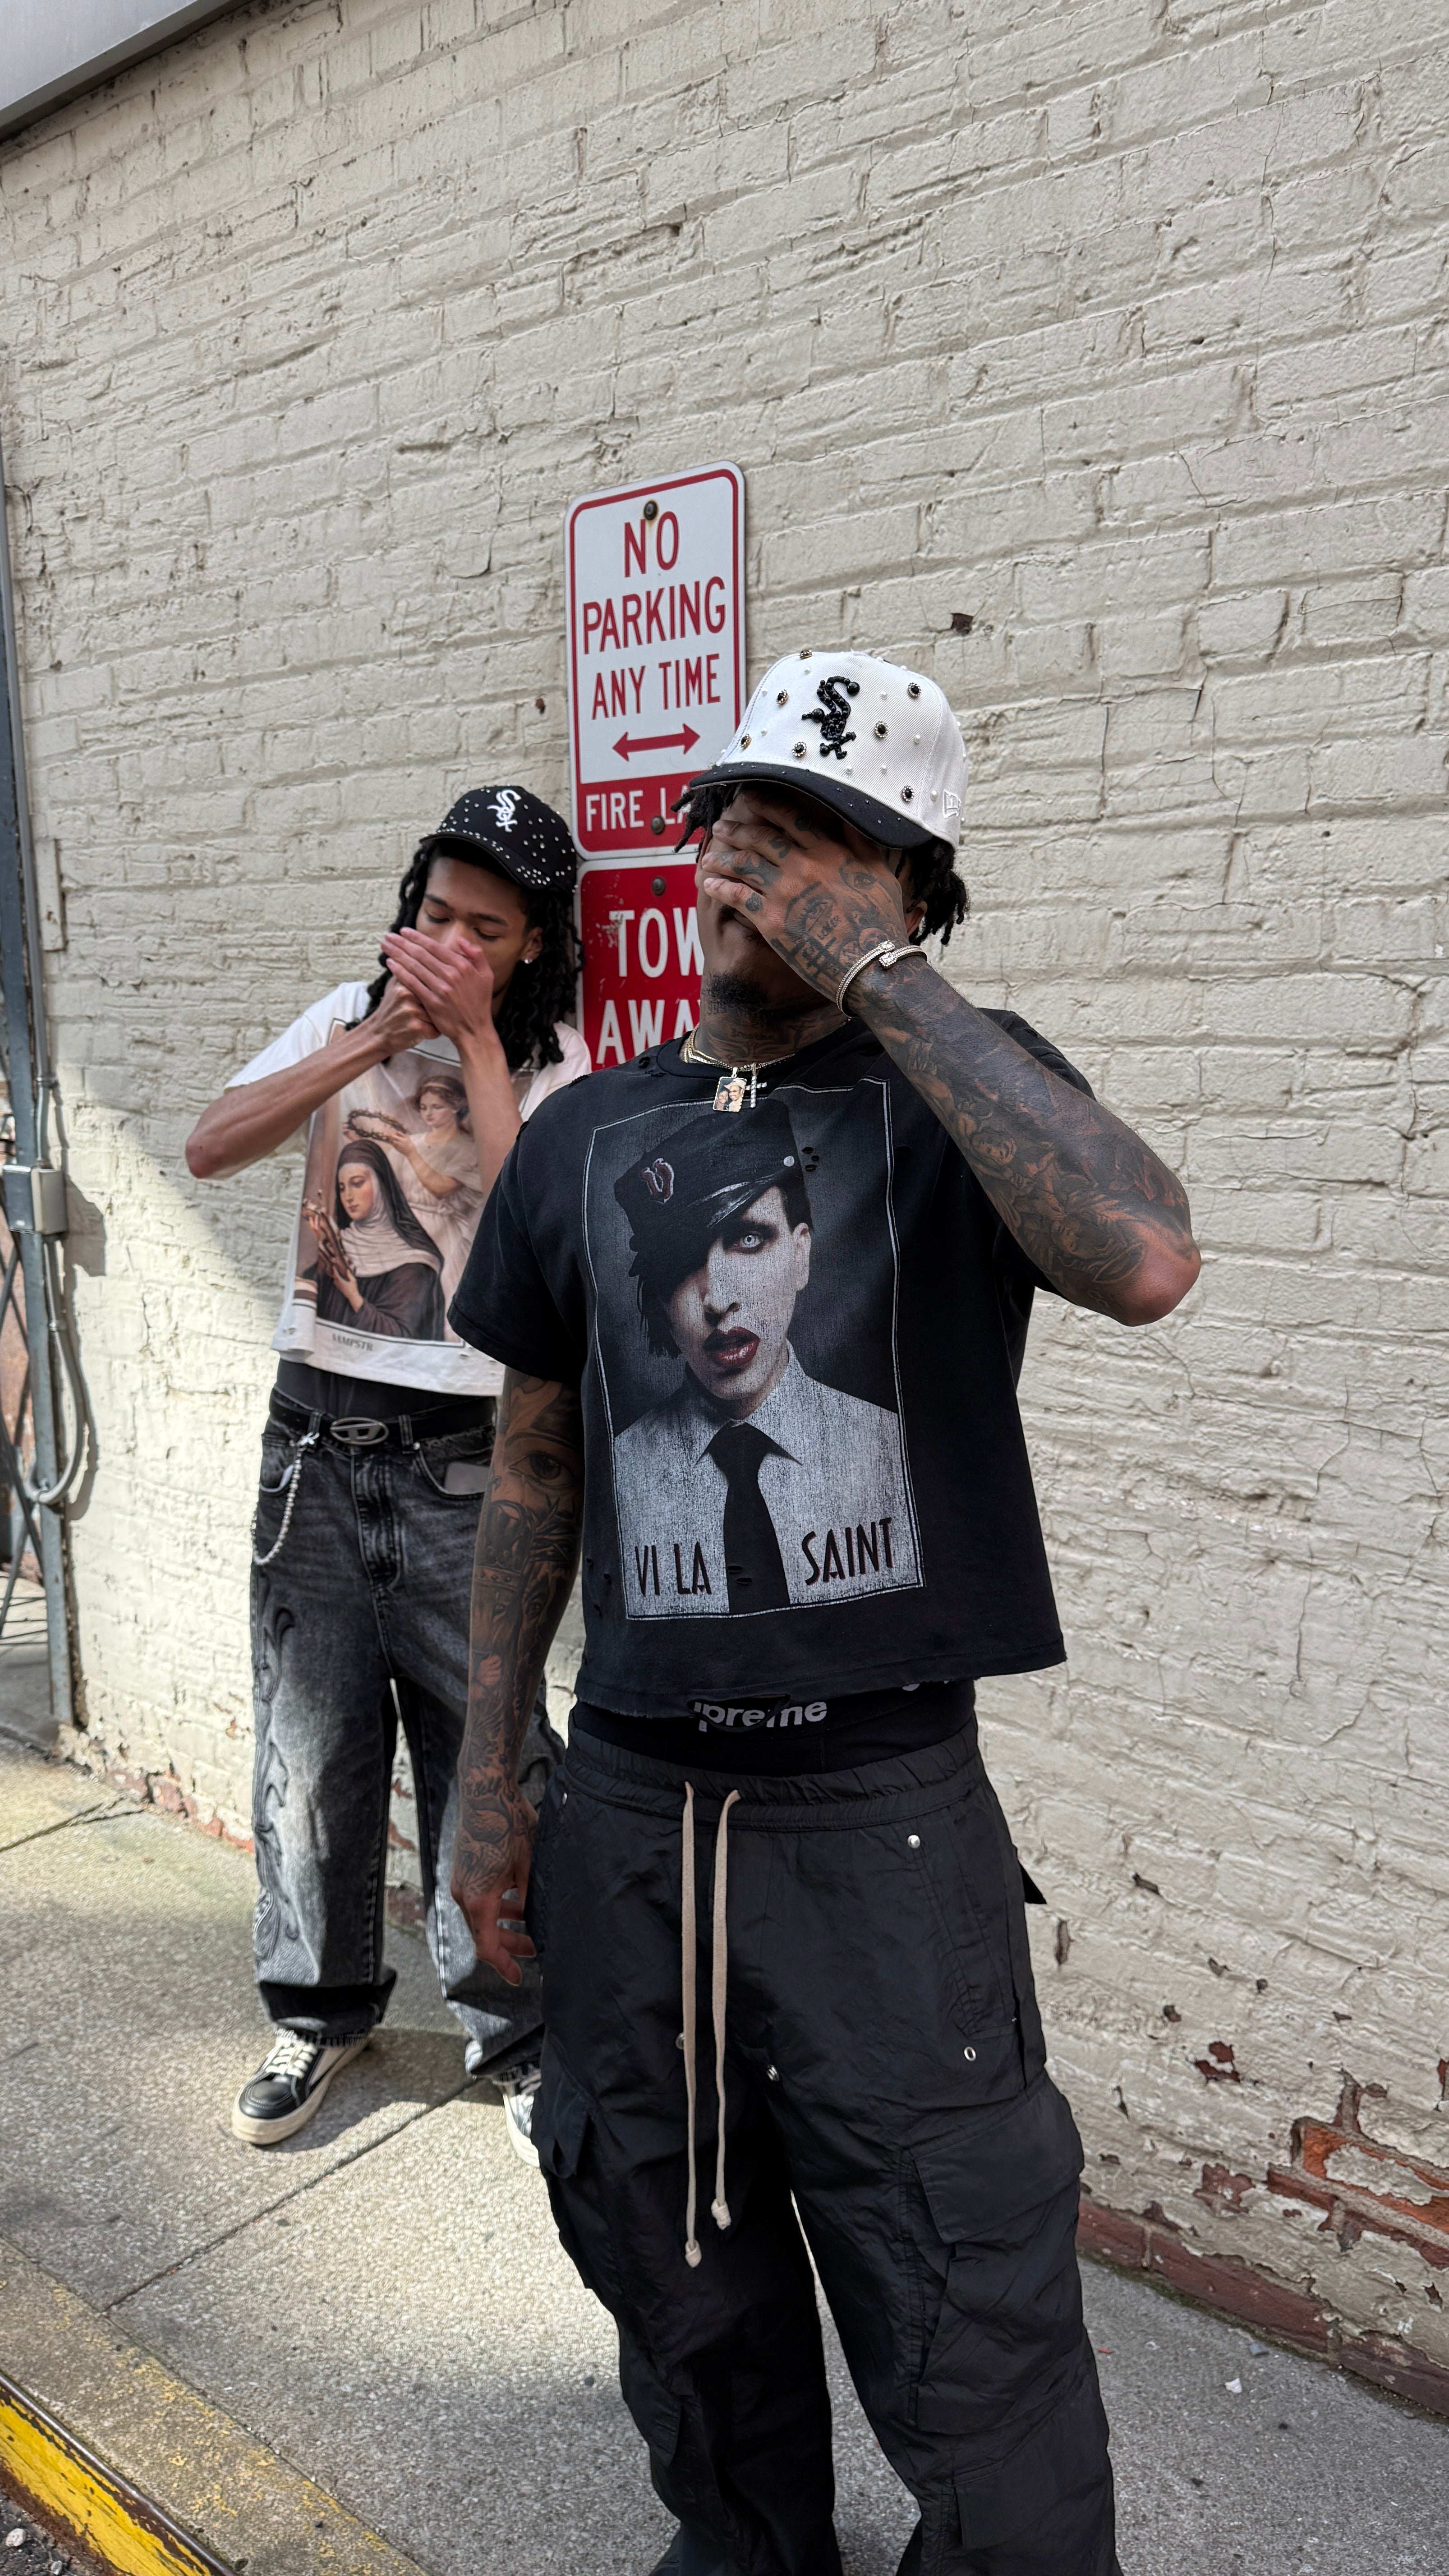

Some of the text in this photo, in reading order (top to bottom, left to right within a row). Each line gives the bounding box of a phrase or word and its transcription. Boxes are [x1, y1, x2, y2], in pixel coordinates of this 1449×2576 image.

[625, 511, 679, 578] NO
[584, 576, 725, 654] PARKING
[592, 653, 720, 720] ANY TIME
[586, 785, 692, 832] FIRE LA
[596, 999, 700, 1064] AWA
[801, 1517, 893, 1586] SAINT
